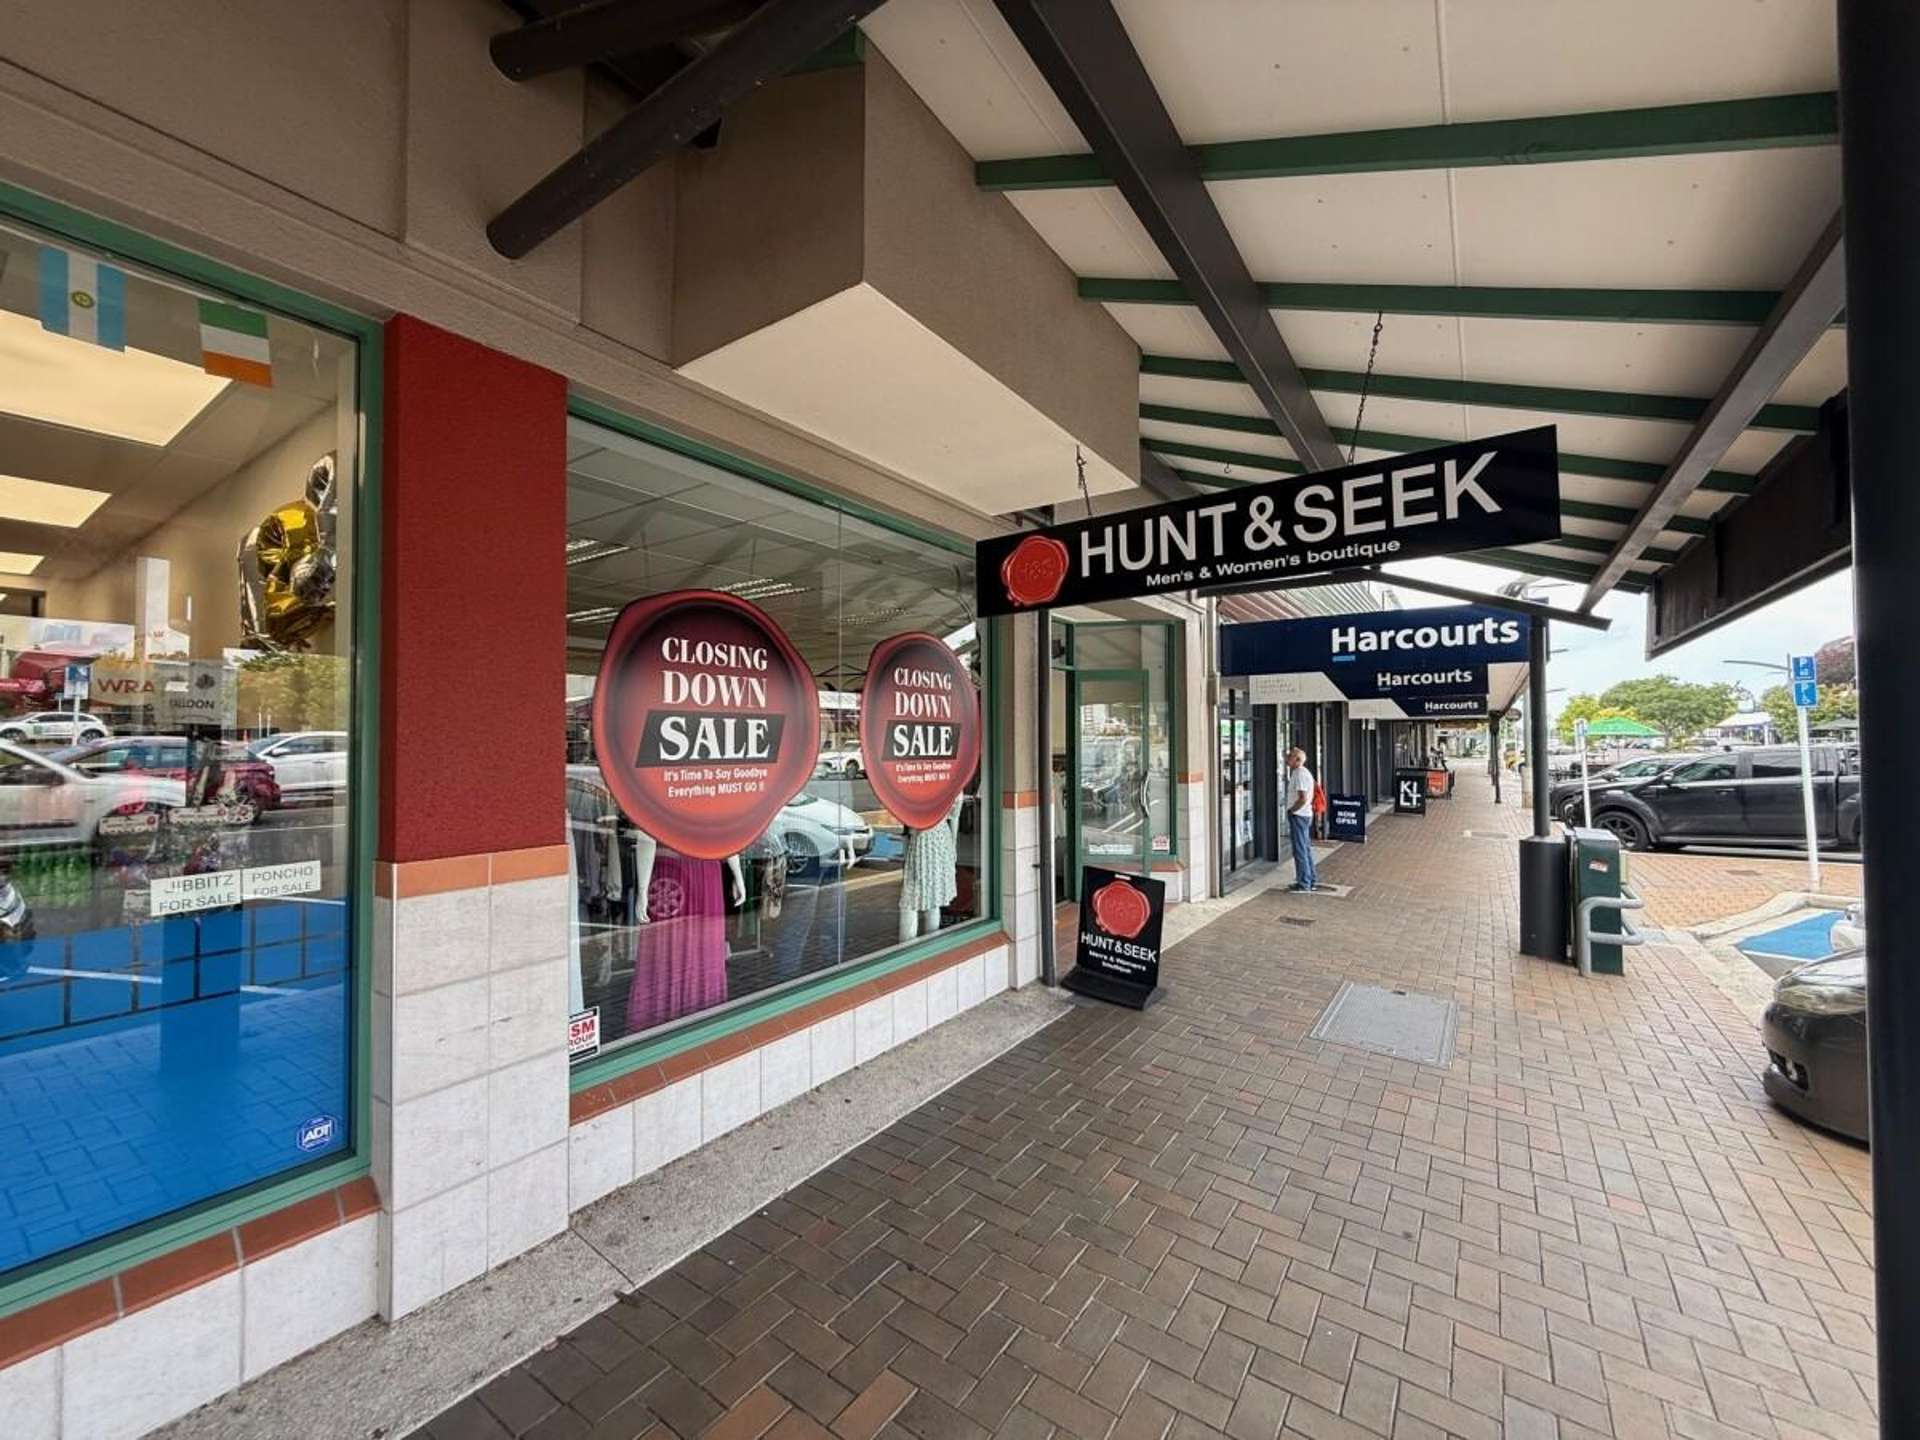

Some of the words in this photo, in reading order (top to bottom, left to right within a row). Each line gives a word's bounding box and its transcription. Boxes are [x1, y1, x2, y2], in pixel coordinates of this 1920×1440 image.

[1146, 570, 1194, 586] Men's
[1199, 566, 1212, 579] &
[1216, 554, 1301, 576] Women's
[1307, 540, 1401, 563] boutique
[1332, 617, 1520, 654] Harcourts
[661, 636, 769, 672] CLOSING
[661, 670, 767, 708] DOWN
[894, 667, 952, 690] CLOSING
[1377, 669, 1473, 687] Harcourts
[895, 691, 952, 719] DOWN
[1424, 700, 1479, 710] Harcourts
[659, 716, 770, 761] SALE
[893, 724, 953, 757] SALE
[664, 770, 679, 782] It's
[680, 769, 702, 781] Time
[704, 769, 713, 780] To
[734, 767, 768, 780] Goodbye
[668, 784, 716, 798] Everything
[718, 782, 742, 794] MUST
[744, 781, 757, 792] GO
[252, 865, 314, 883] PONCHO
[253, 886, 278, 898] FOR
[282, 880, 314, 894] SALE
[159, 900, 192, 913] FOR
[195, 892, 236, 906] SALE
[570, 1019, 595, 1038] SM
